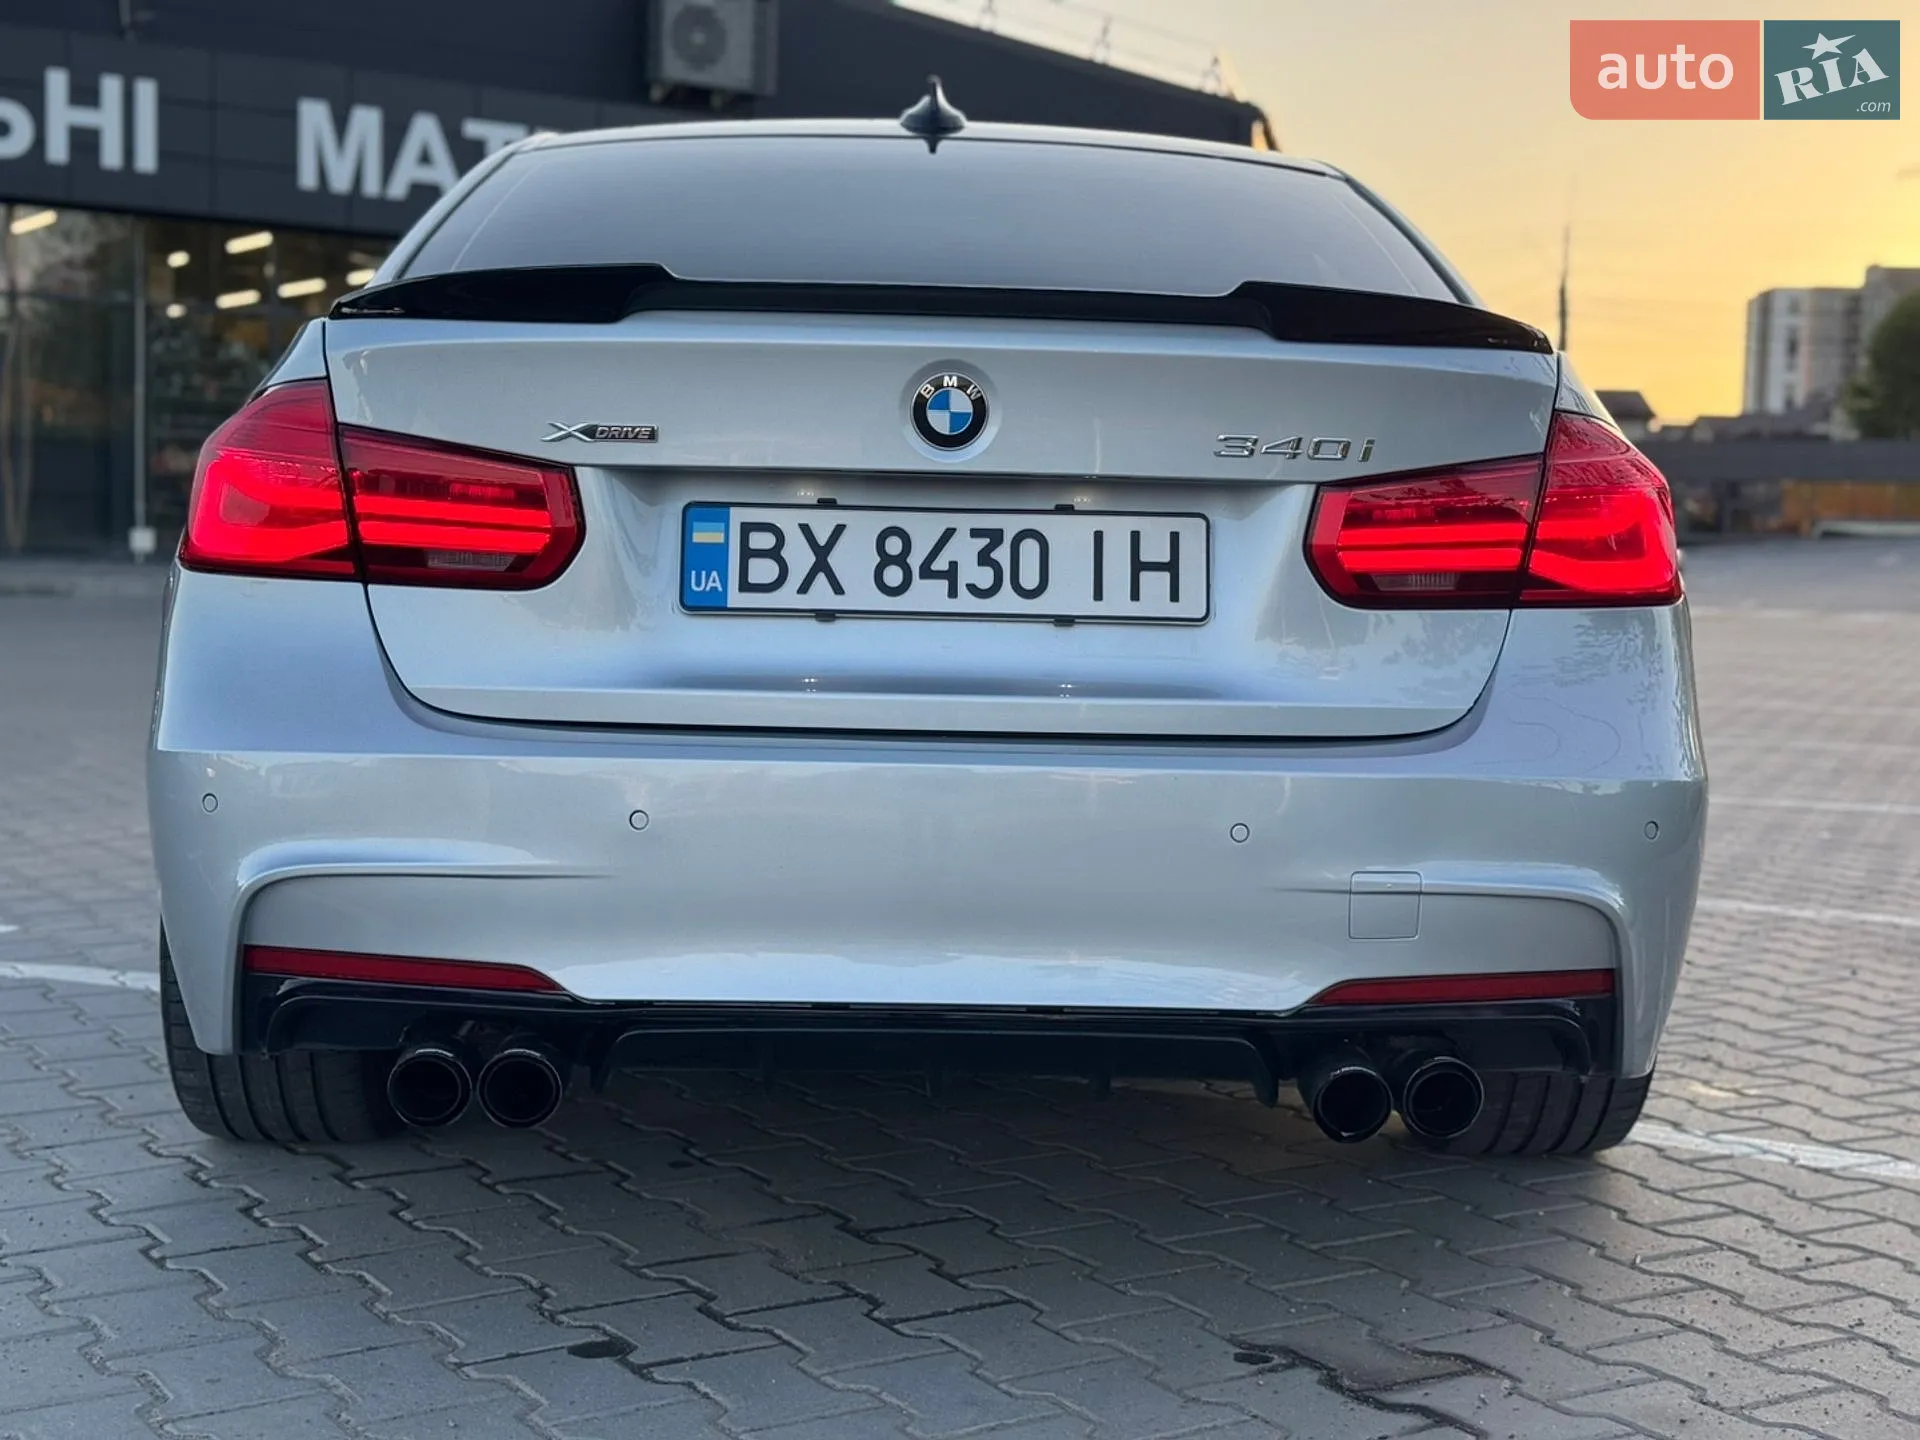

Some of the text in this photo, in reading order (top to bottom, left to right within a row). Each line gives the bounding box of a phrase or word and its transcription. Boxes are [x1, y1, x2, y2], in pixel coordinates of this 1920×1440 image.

[297, 97, 553, 200] МАТ
[920, 375, 981, 401] BMW
[1213, 434, 1376, 463] 340i
[738, 521, 1180, 602] BX 8430 IH
[690, 569, 723, 592] UA
